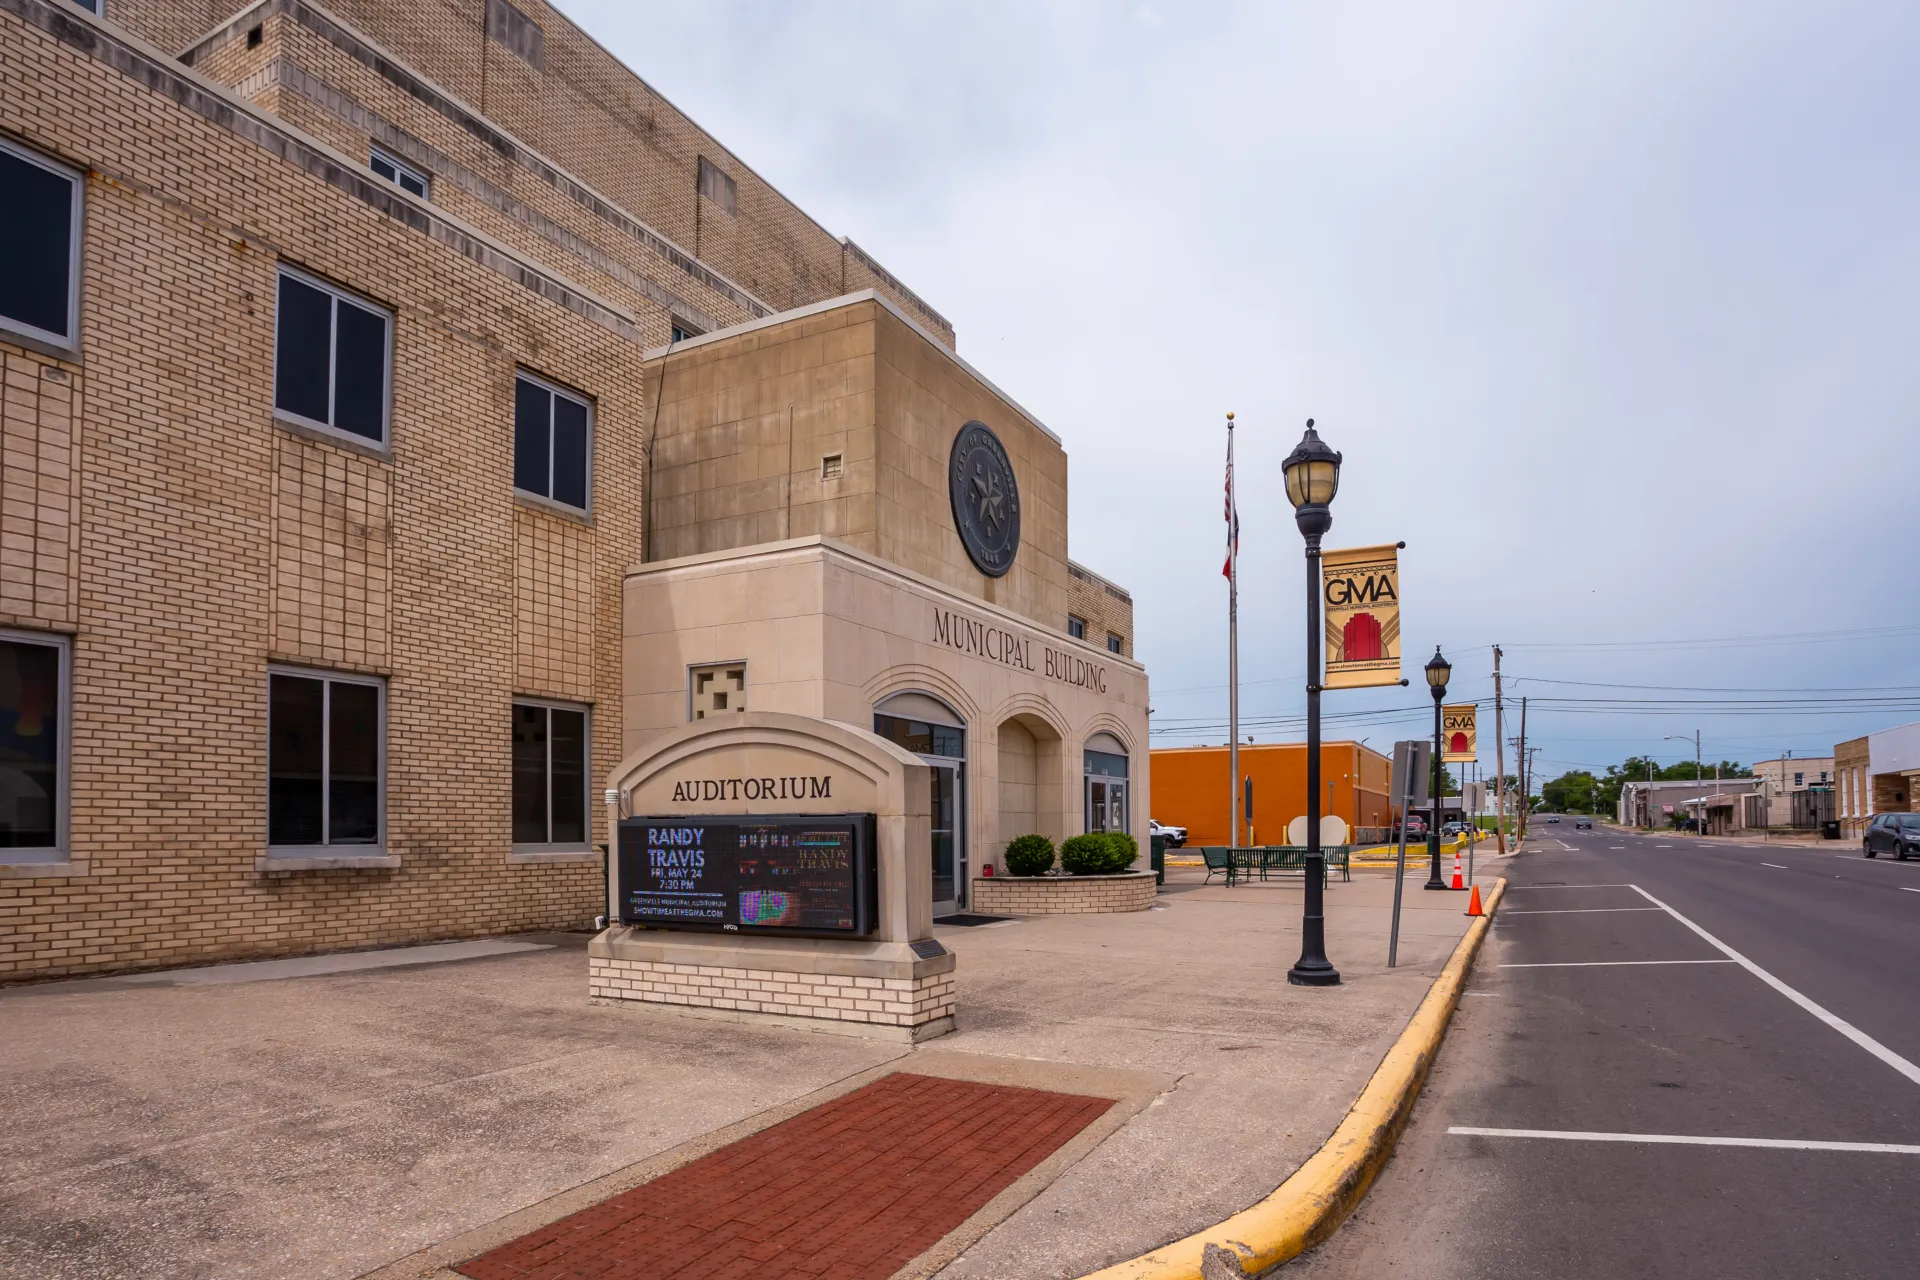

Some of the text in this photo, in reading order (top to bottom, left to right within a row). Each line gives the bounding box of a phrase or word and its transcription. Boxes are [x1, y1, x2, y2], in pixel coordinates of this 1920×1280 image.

[957, 448, 967, 482] CITY
[969, 434, 977, 447] OF
[1326, 575, 1397, 606] GMA
[933, 608, 1107, 694] MUNICIPAL BUILDING
[1443, 716, 1475, 728] GMA
[671, 776, 832, 802] AUDITORIUM
[648, 828, 704, 845] RANDY
[647, 849, 705, 867] TRAVIS
[668, 868, 689, 878] MAY
[691, 869, 702, 878] 24
[660, 880, 694, 890] 7:30 PM
[633, 907, 723, 917] SHOWTIMEATTHEGMA.COM
